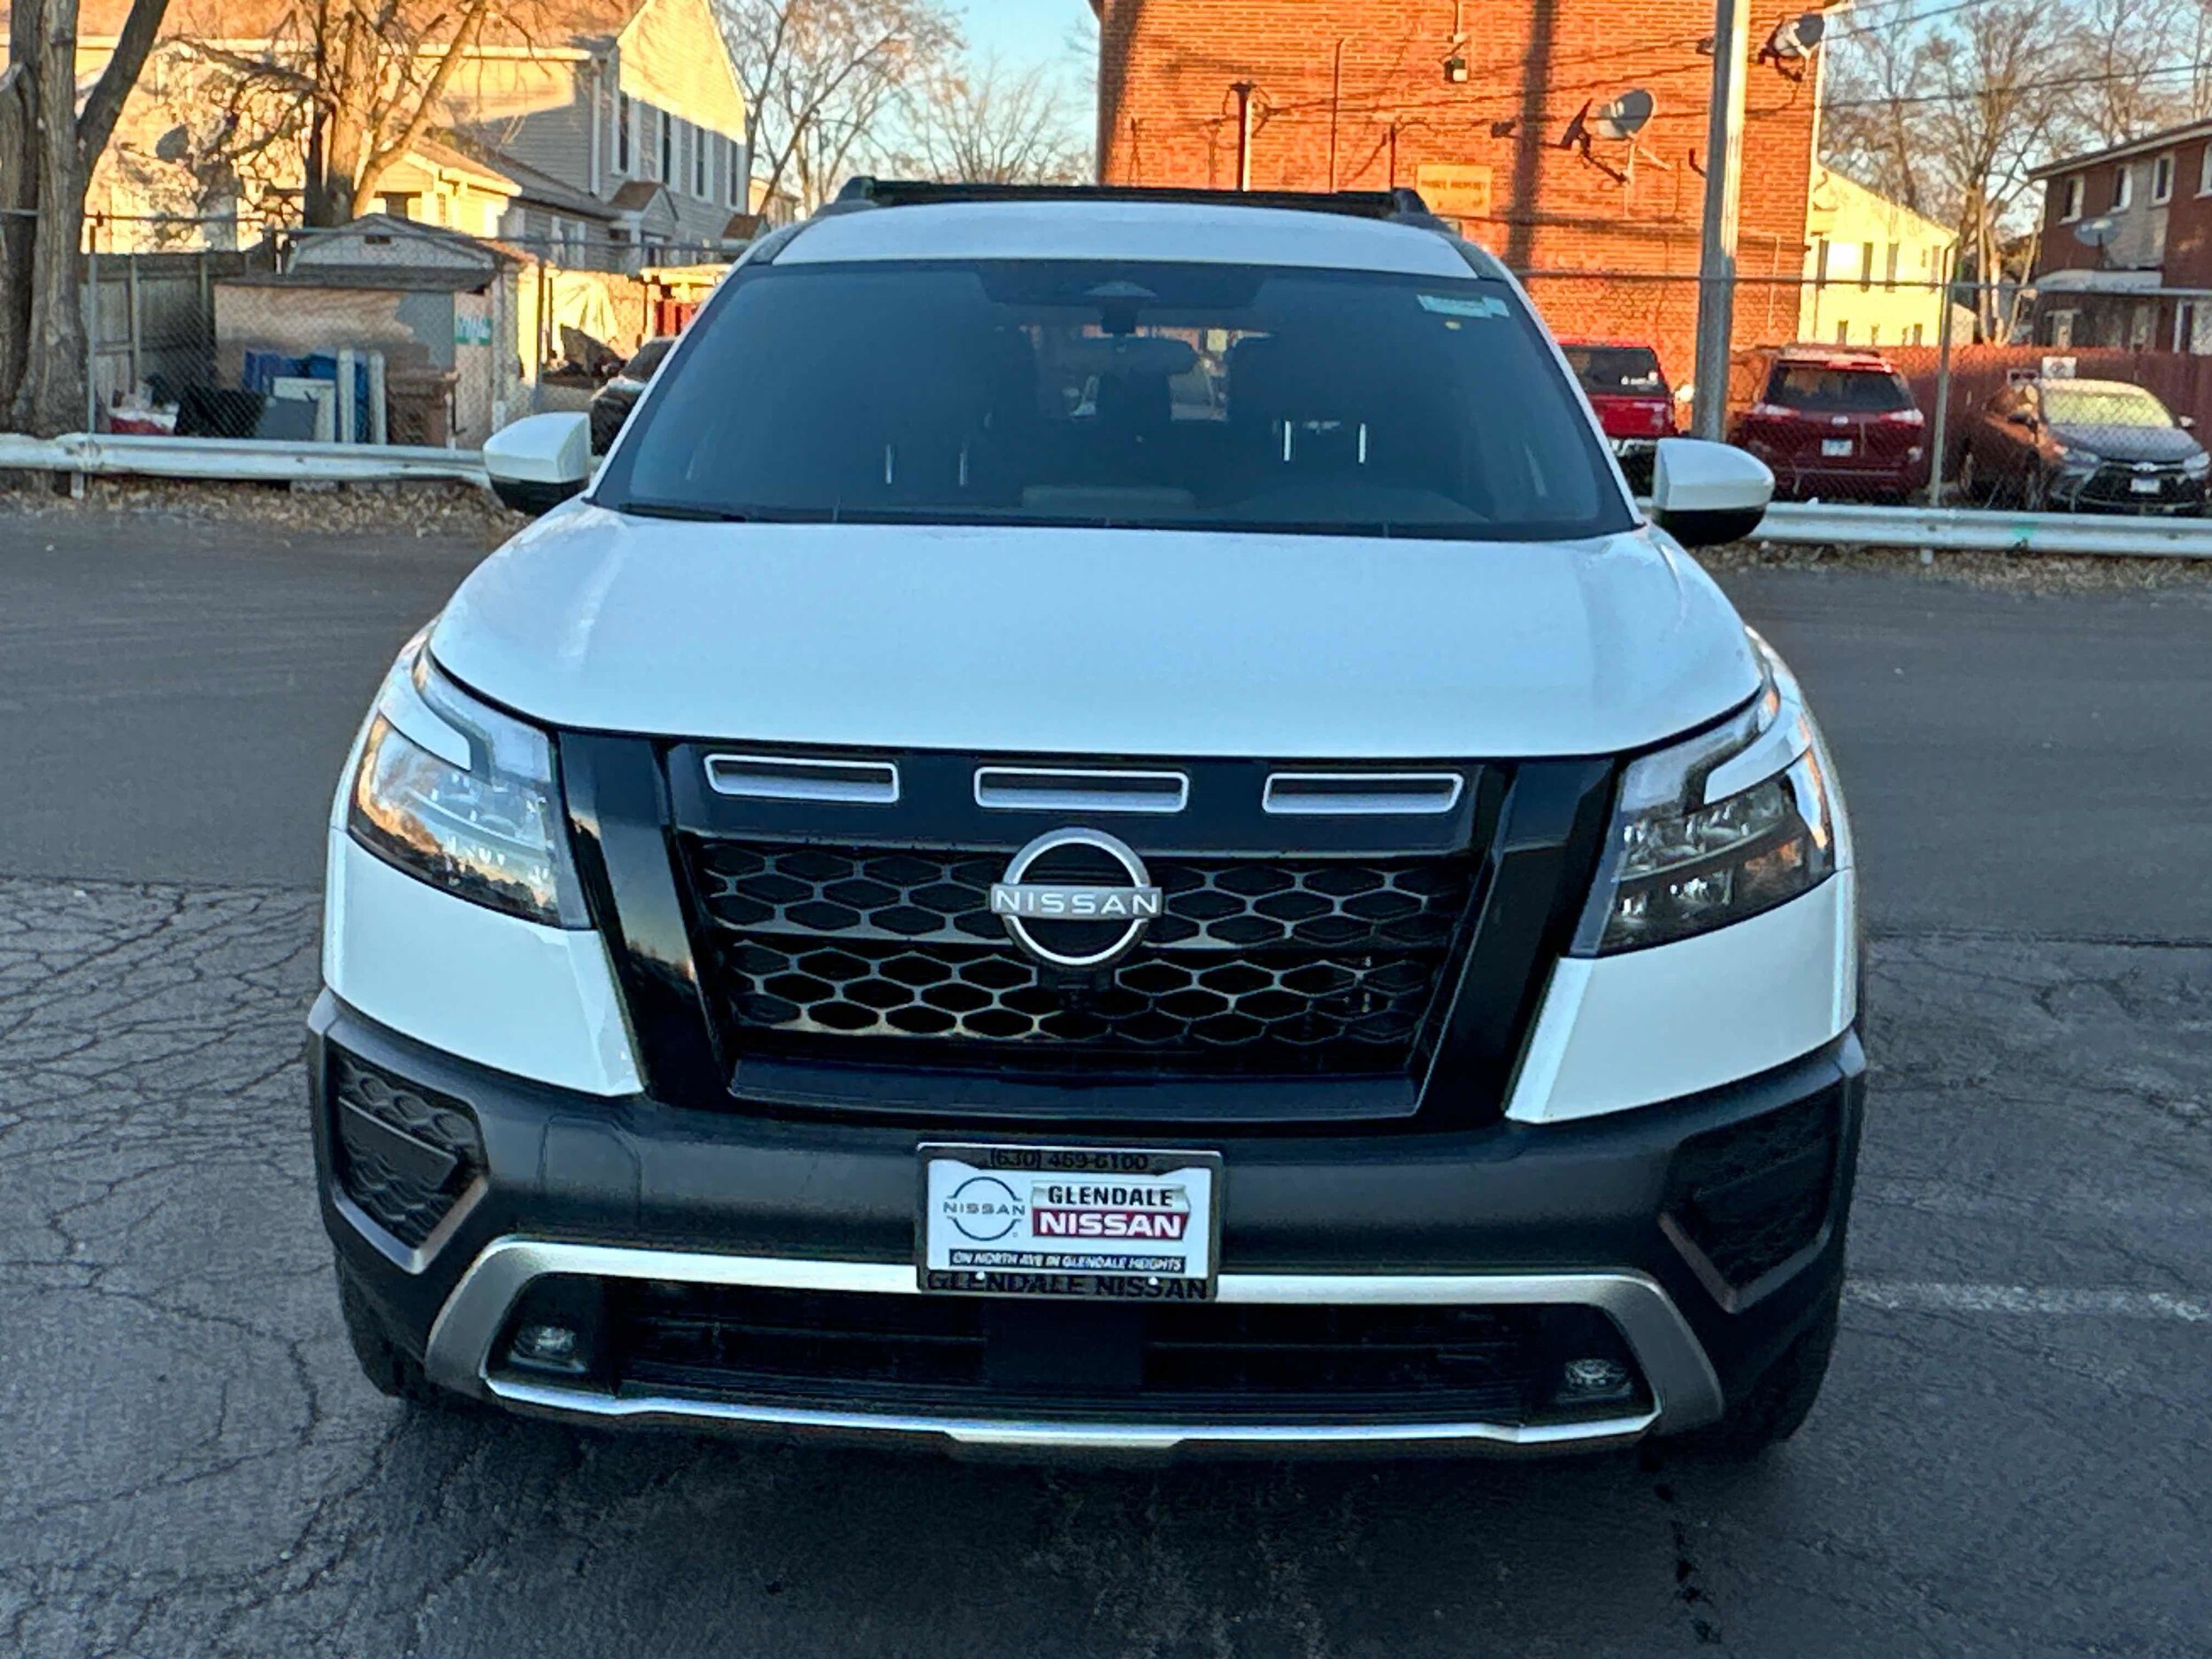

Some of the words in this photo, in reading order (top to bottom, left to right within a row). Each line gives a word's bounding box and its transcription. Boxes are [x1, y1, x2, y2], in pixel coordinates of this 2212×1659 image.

[995, 889, 1158, 915] NISSAN
[1048, 1185, 1173, 1208] GLENDALE
[942, 1202, 1025, 1216] NISSAN
[1039, 1211, 1181, 1238] NISSAN
[952, 1250, 972, 1263] ON
[973, 1252, 1018, 1265] NORTH
[1062, 1256, 1126, 1270] GLENDALE
[1127, 1258, 1182, 1271] HEIGHTS
[926, 1270, 1089, 1293] GLENDALE
[1096, 1274, 1207, 1299] NISSAN
